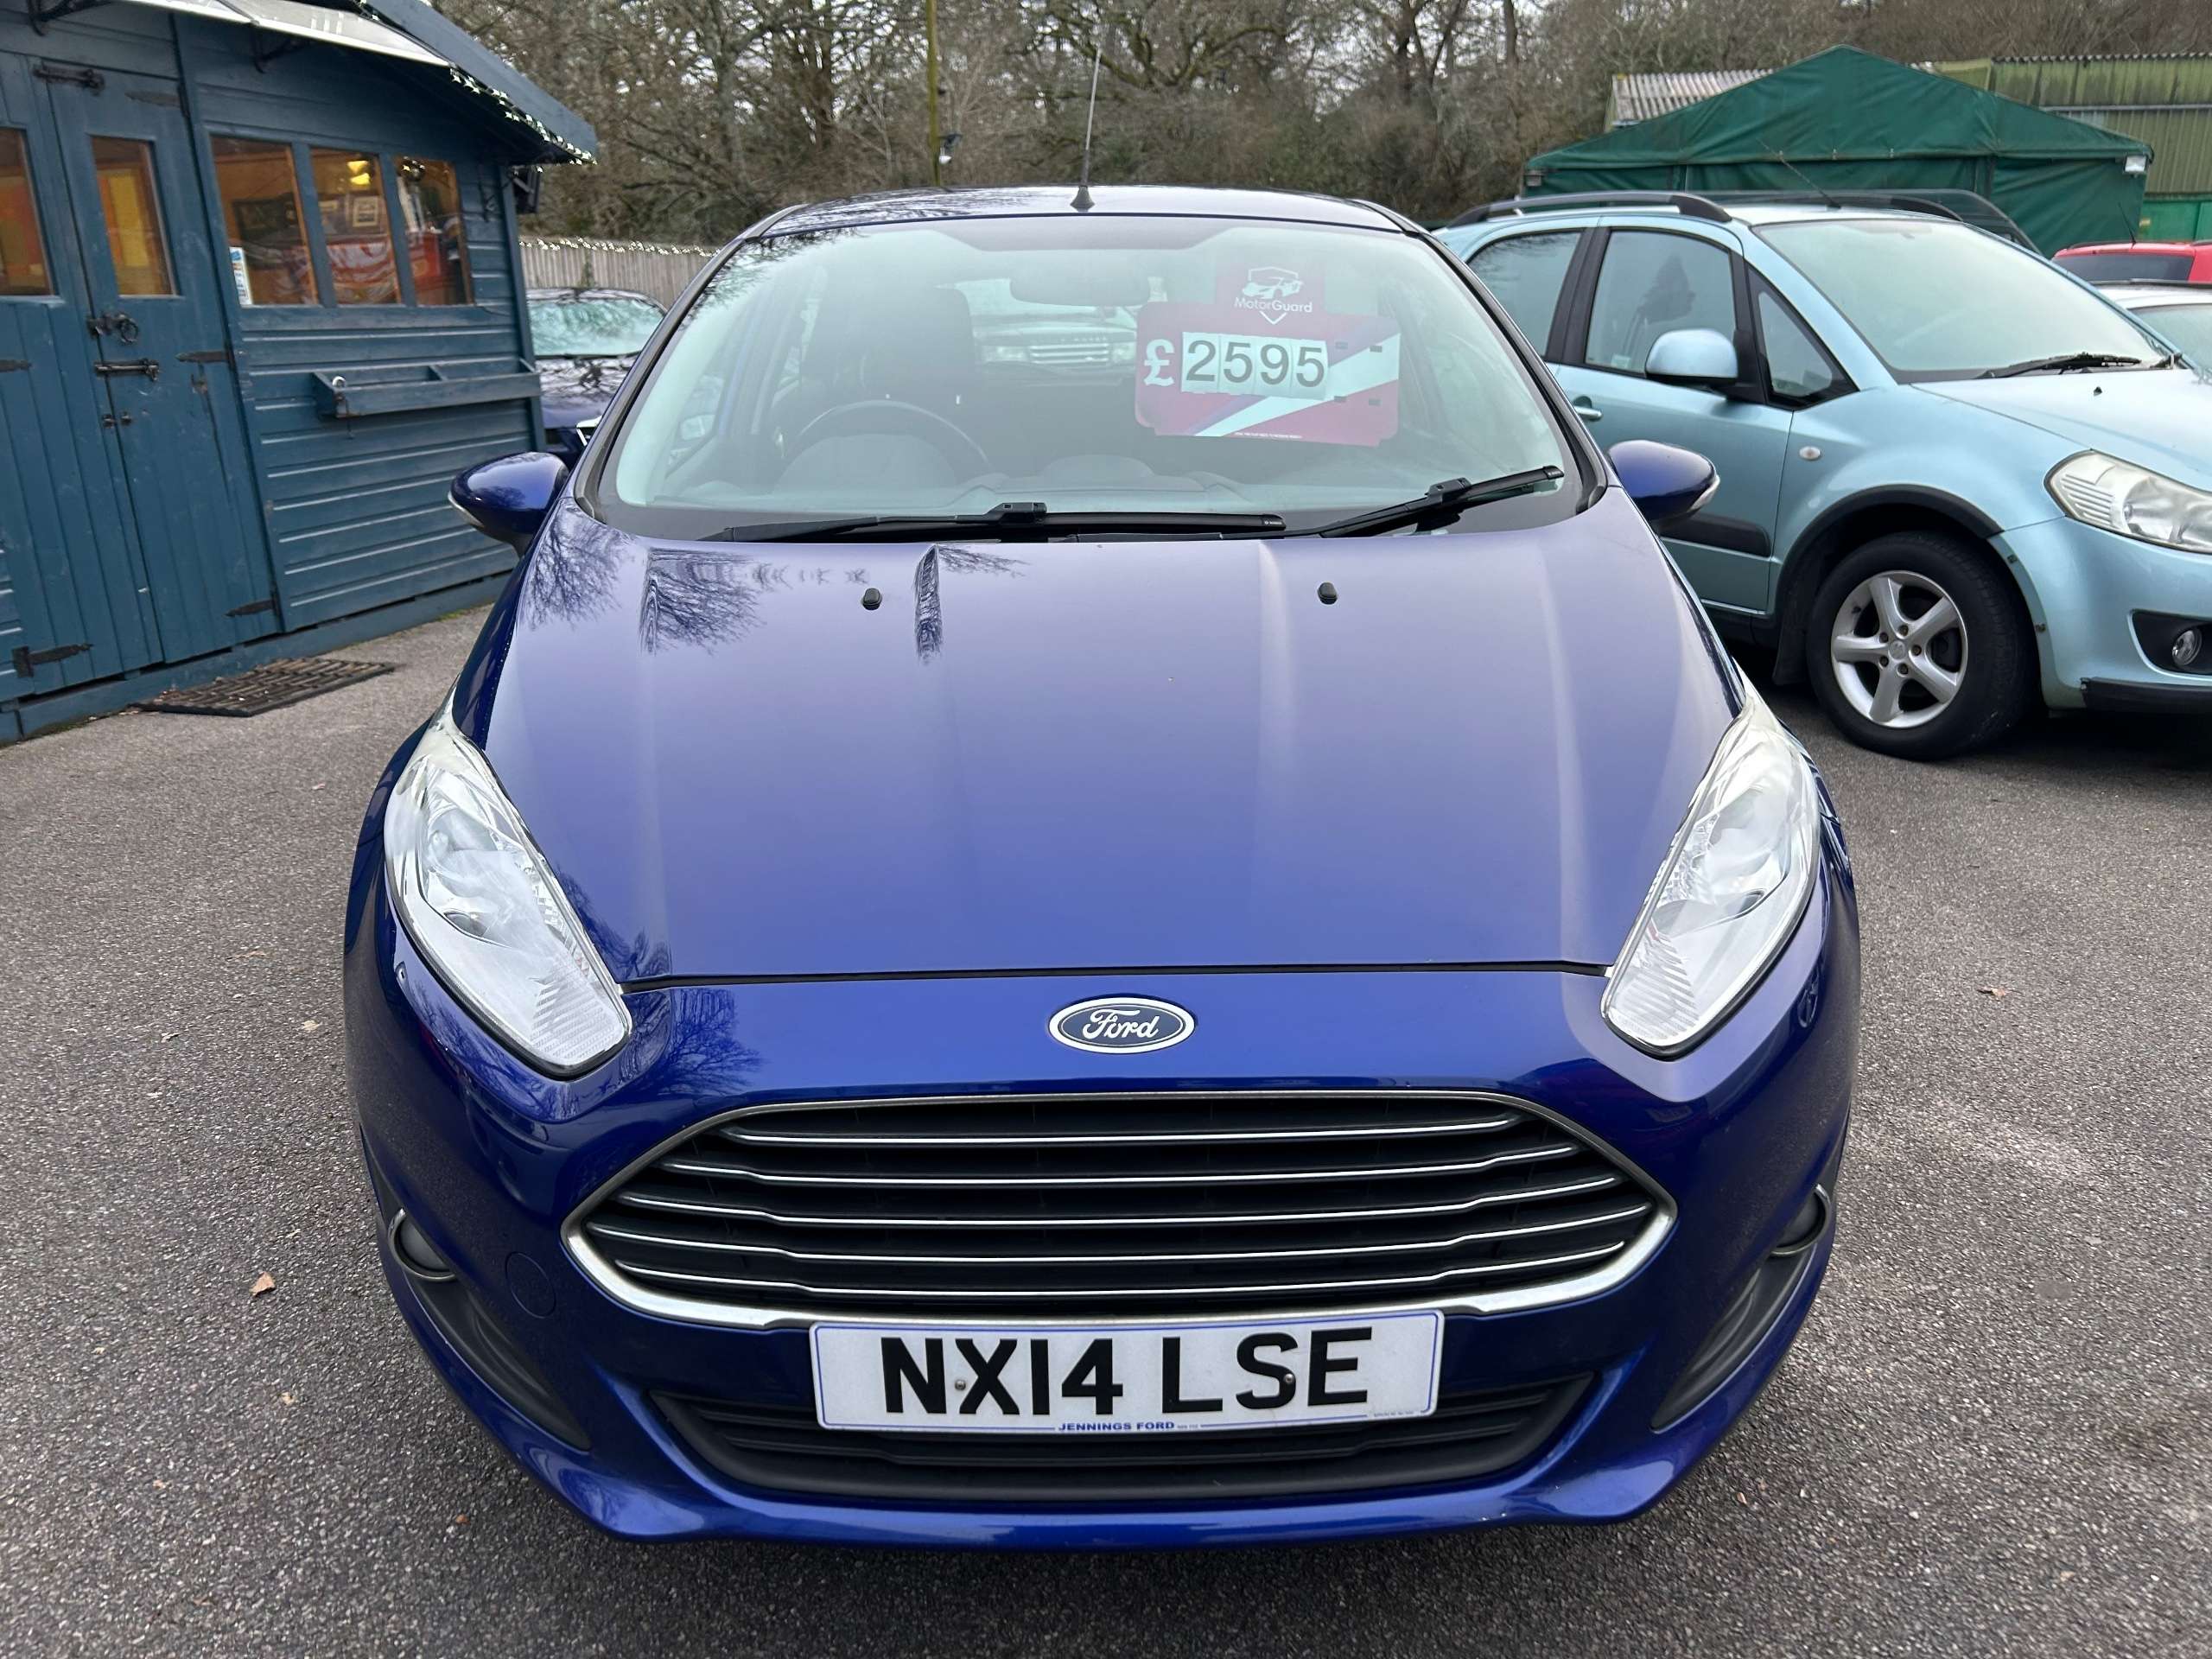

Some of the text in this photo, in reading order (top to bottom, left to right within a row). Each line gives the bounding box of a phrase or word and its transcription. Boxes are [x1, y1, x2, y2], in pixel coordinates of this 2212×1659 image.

[1234, 296, 1313, 314] MotorGuard
[1082, 1008, 1160, 1039] Ford
[880, 1326, 1373, 1415] NX14 LSE
[1058, 1421, 1132, 1432] JENNINGS
[1136, 1421, 1175, 1431] FORD
